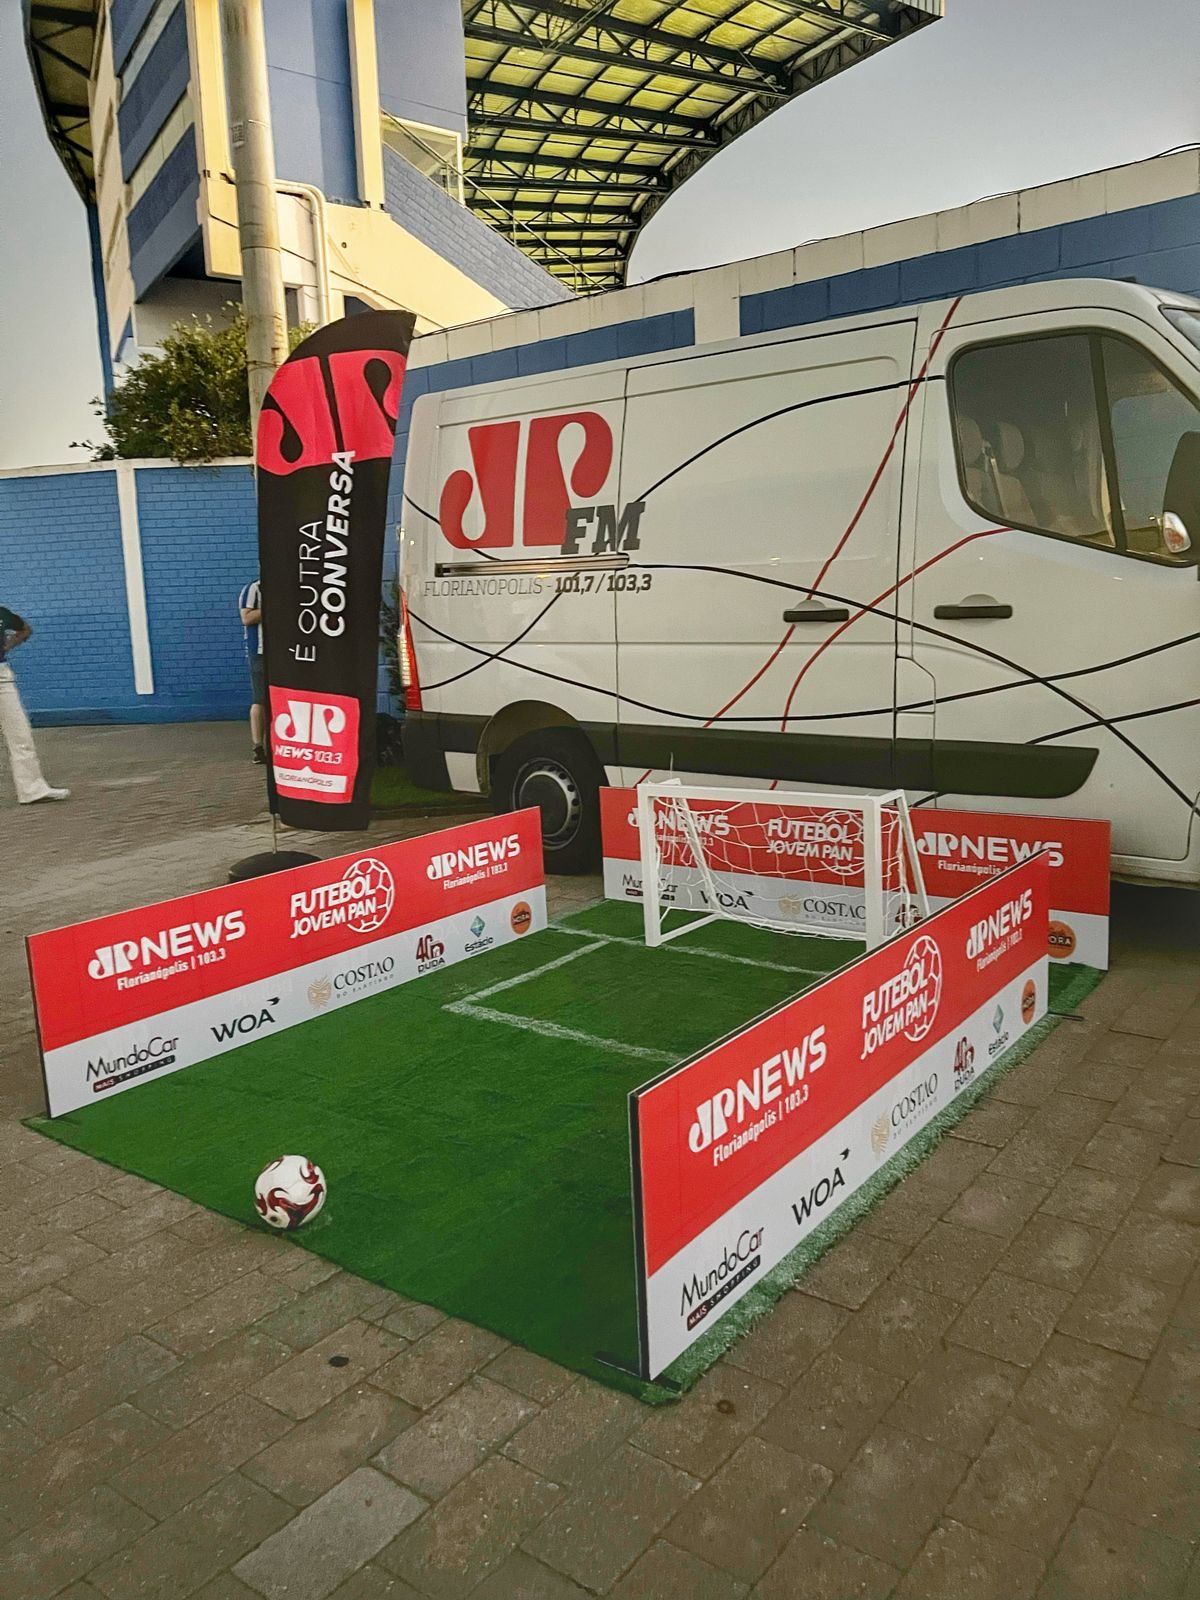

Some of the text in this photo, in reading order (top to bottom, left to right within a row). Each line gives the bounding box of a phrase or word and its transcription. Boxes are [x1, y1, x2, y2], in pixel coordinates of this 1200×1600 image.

[439, 411, 613, 549] JP
[319, 450, 356, 637] CONVERSA
[560, 501, 646, 555] FM
[289, 520, 323, 662] É OUTRA
[555, 576, 595, 596] 101,7
[606, 574, 652, 594] 103,3
[275, 700, 346, 747] JP
[275, 744, 342, 765] NEWS 103.3
[766, 839, 853, 861] JOVEM PAN
[767, 818, 853, 844] FUTEBOL
[937, 860, 1001, 876] Florianópolis
[290, 873, 376, 918] FUTEBOL
[290, 897, 376, 938] JOVEM PAN
[417, 957, 446, 973] DUDA
[861, 958, 928, 1030] FUTEBOL
[210, 1008, 276, 1042] WOA
[860, 1007, 904, 1060] JOVEM
[905, 990, 928, 1027] PAN
[86, 1036, 179, 1082] MundoCar
[713, 1109, 777, 1167] Florianópolis
[785, 1084, 809, 1114] 103.3
[791, 1167, 846, 1226] WOA
[680, 1227, 764, 1317] MundoCar
